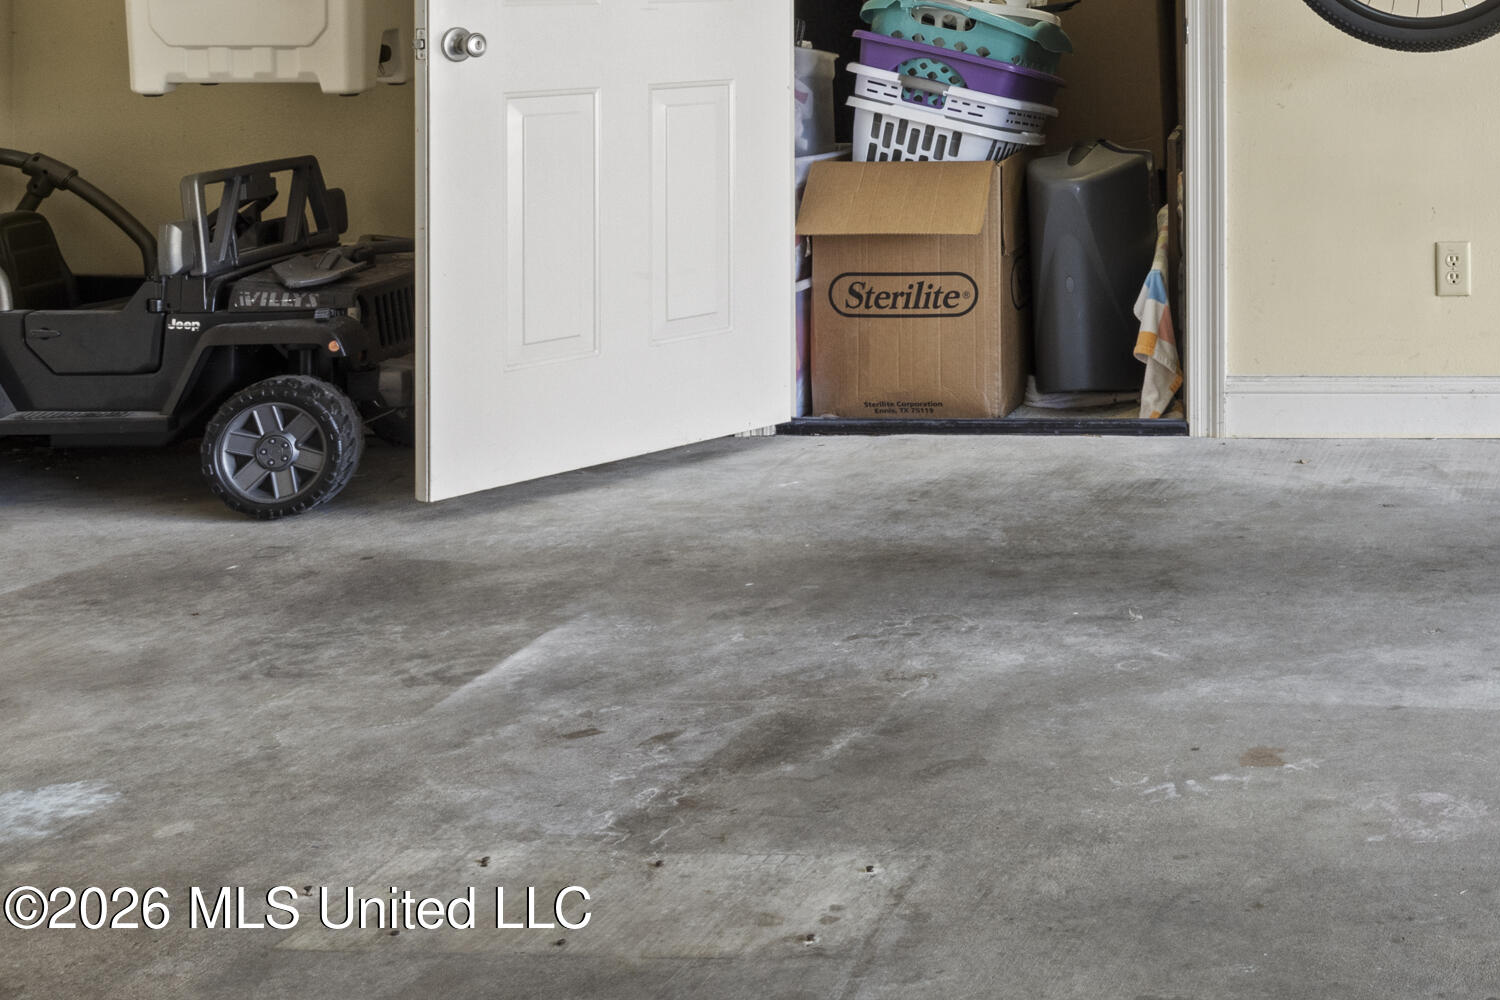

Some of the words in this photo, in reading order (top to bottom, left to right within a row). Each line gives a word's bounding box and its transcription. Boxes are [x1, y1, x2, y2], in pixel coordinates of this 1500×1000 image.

[239, 291, 320, 307] WILLYS
[168, 318, 201, 332] Jeep
[896, 401, 943, 409] Corporation
